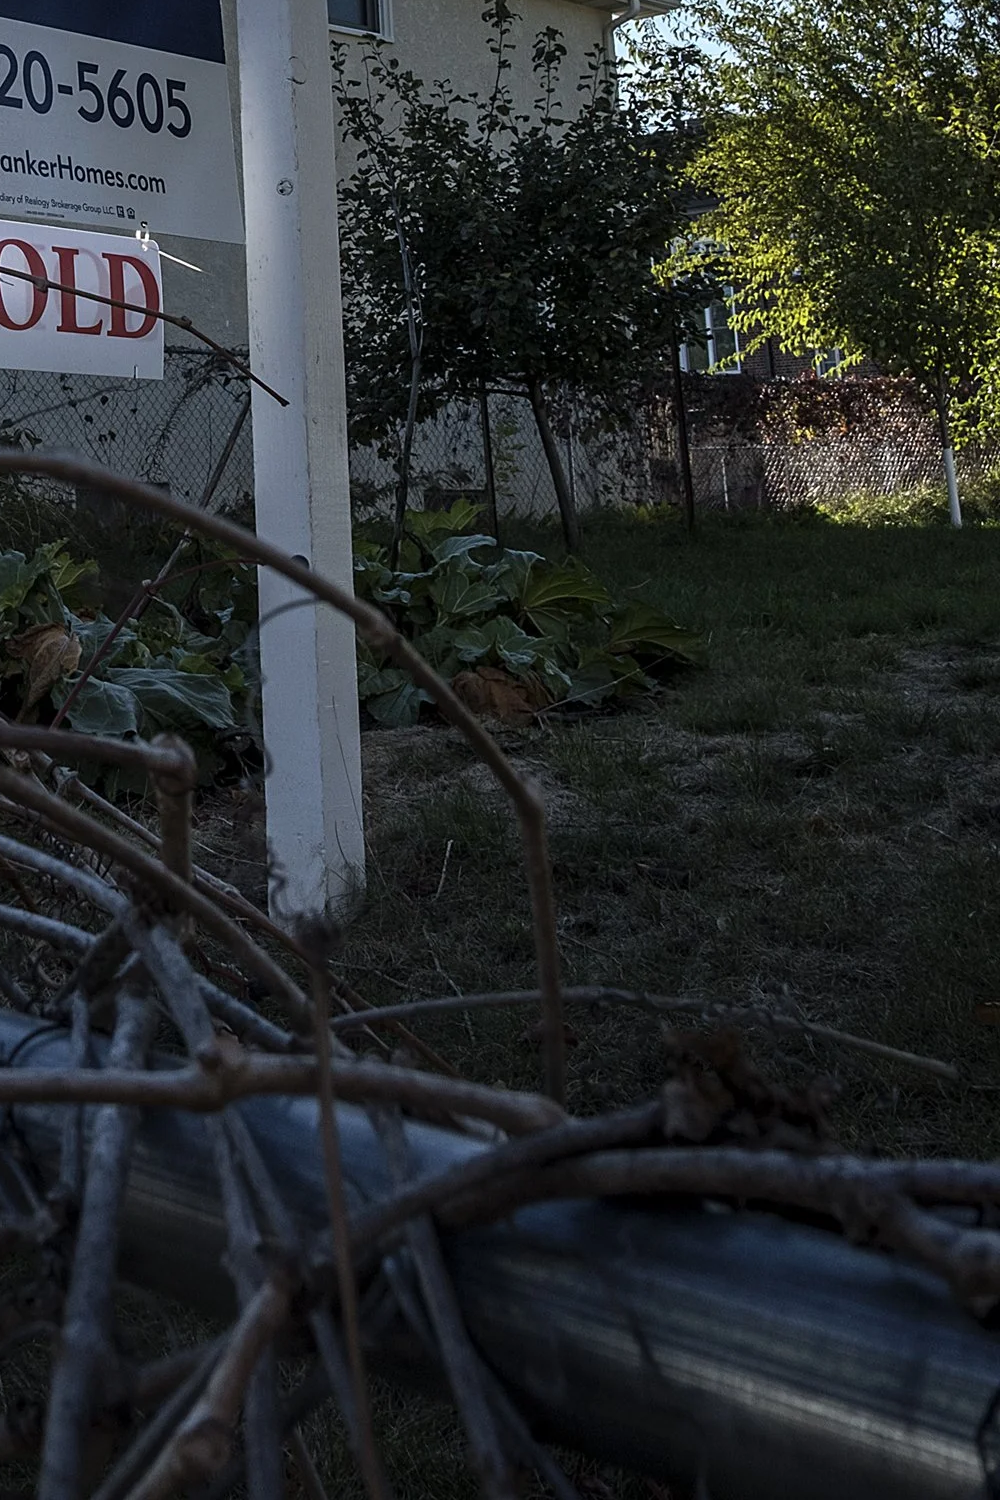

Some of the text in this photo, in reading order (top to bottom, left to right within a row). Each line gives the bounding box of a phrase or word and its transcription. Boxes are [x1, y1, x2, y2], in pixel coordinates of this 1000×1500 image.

[16, 194, 24, 204] of
[24, 195, 50, 209] Realogy
[50, 198, 82, 213] Brokerage
[82, 202, 102, 215] Group
